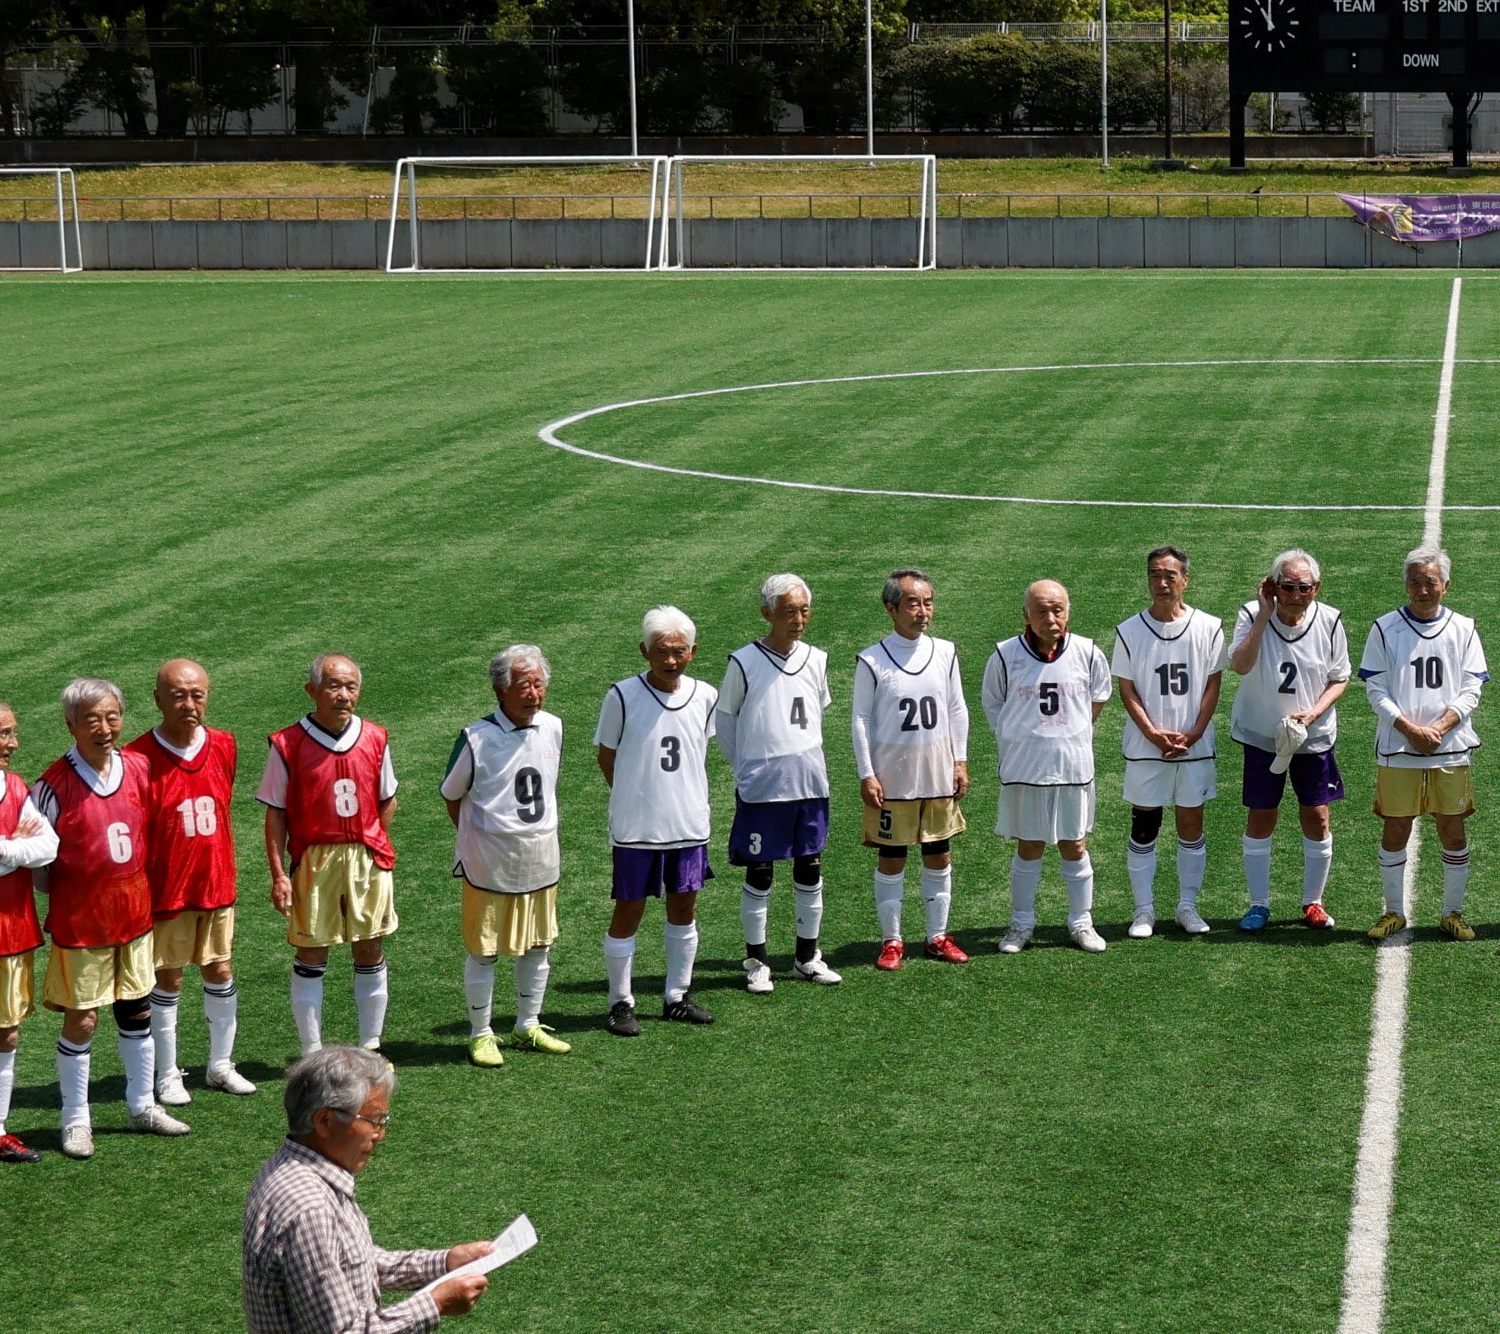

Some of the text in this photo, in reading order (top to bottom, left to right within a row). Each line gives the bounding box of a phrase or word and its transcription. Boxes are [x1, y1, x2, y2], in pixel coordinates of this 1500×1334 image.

[1333, 0, 1375, 13] TEAM
[1402, 0, 1429, 13] 1ST
[1438, 0, 1468, 13] 2ND
[1403, 54, 1439, 68] DOWN
[1154, 663, 1189, 696] 15
[1278, 661, 1298, 694] 2
[1410, 656, 1444, 689] 10
[790, 696, 808, 730] 4
[898, 695, 938, 731] 20
[1039, 682, 1059, 716] 5
[660, 735, 681, 773] 3
[334, 778, 359, 818] 8
[514, 766, 546, 824] 9
[176, 795, 217, 838] 18
[879, 808, 892, 831] 5
[107, 821, 133, 864] 6
[748, 832, 762, 855] 3
